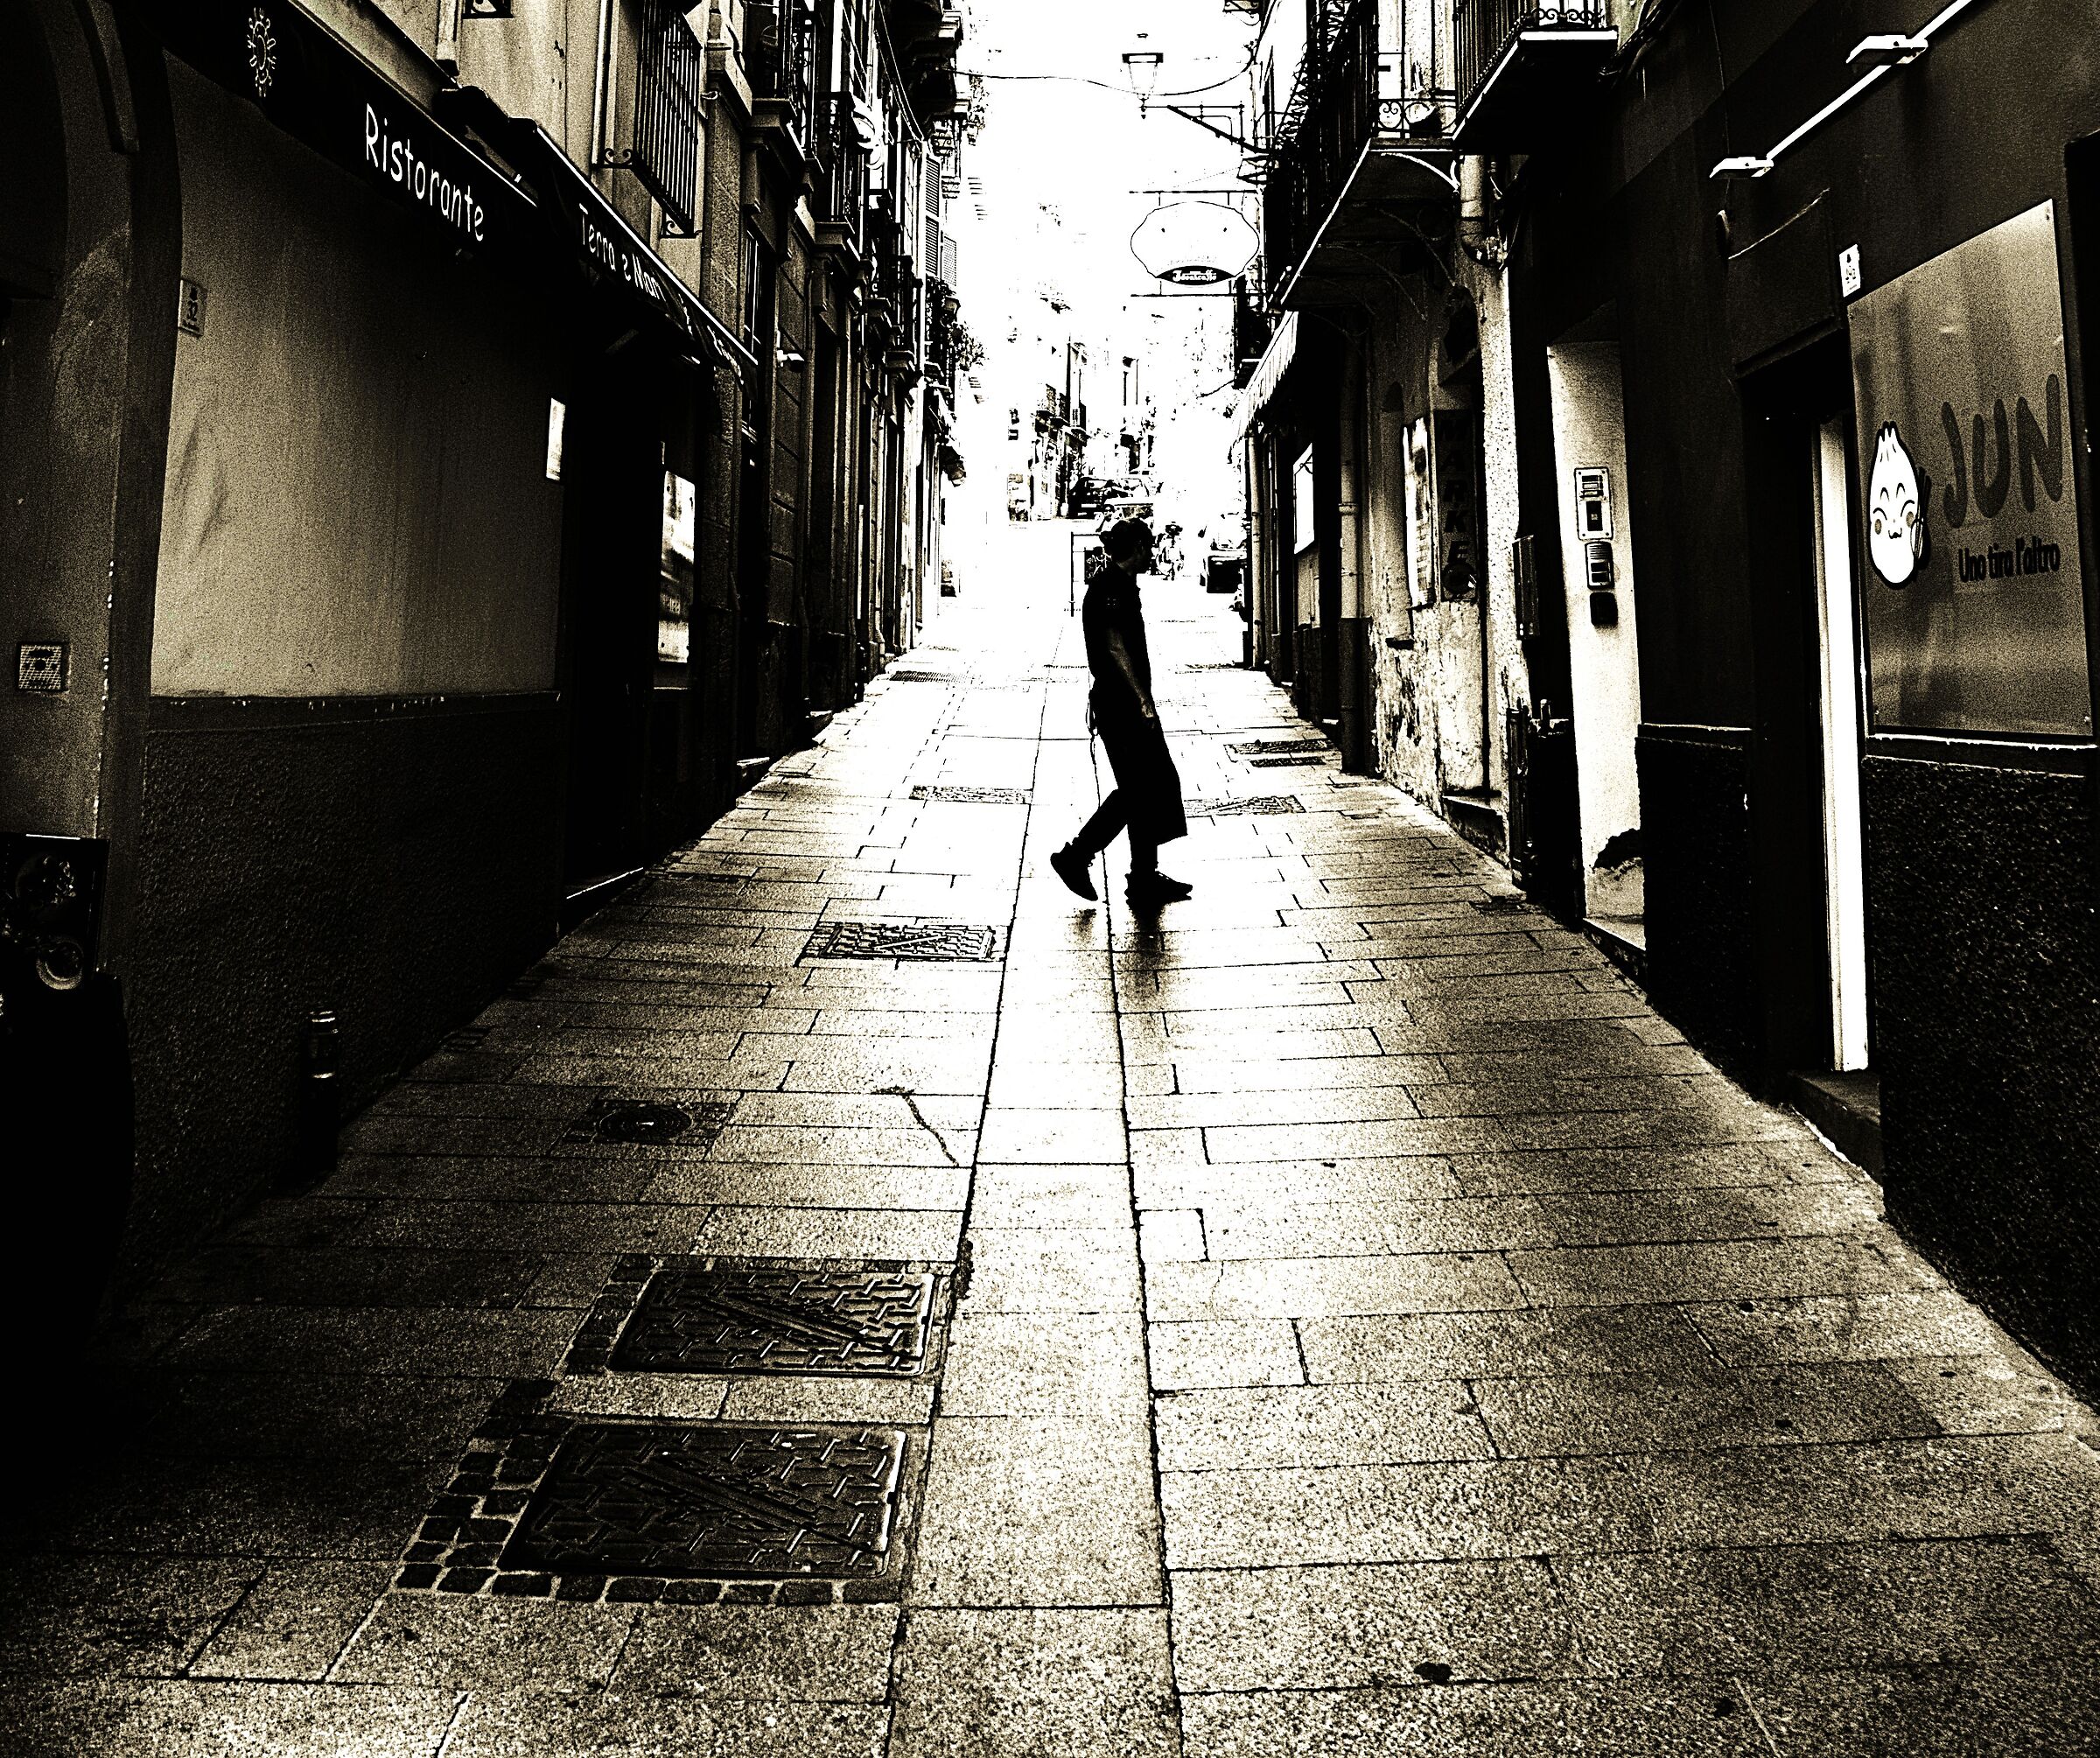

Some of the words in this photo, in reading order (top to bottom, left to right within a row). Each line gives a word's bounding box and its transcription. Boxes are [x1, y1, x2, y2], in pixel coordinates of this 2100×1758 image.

[366, 103, 483, 242] Ristorante
[579, 203, 616, 272] Terra
[1439, 418, 1470, 565] MARKE
[1942, 374, 2062, 529] JUN
[1958, 547, 1986, 583] Uno
[1987, 542, 2013, 578] tira
[2015, 535, 2061, 576] l'altro
